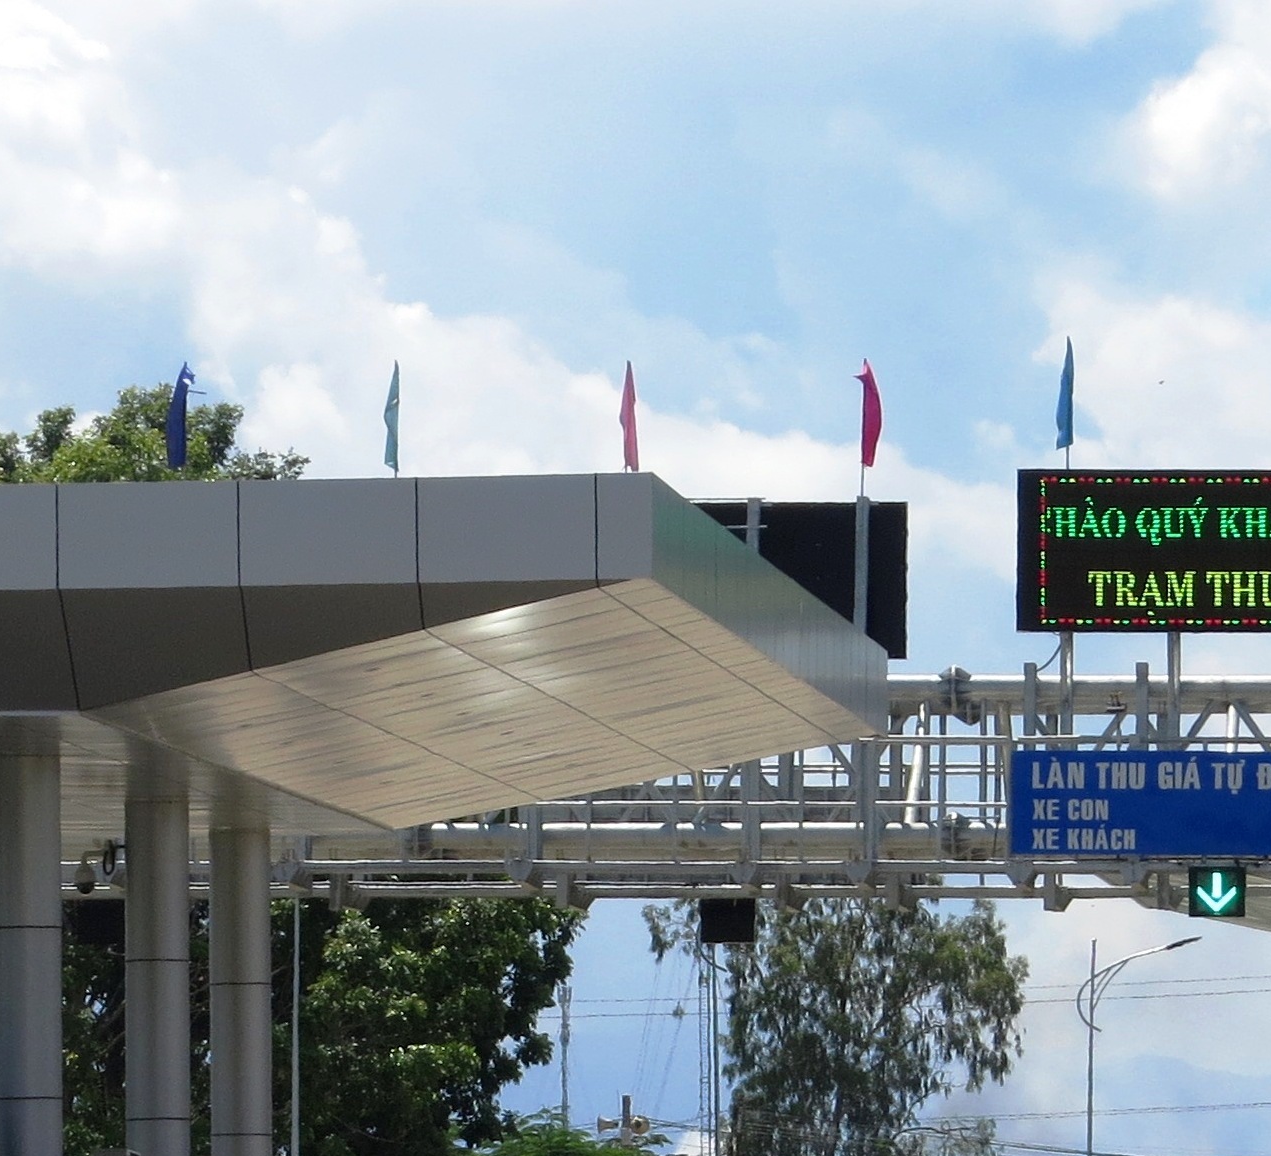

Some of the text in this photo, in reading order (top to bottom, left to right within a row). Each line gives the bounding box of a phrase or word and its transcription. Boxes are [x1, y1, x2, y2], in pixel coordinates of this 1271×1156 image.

[1135, 496, 1209, 546] QUÝ
[1087, 570, 1196, 616] TRẠM
[1032, 756, 1085, 790] LÀN
[1096, 761, 1146, 790] THU
[1157, 756, 1201, 790] GIÁ
[1211, 759, 1245, 795] TỰ
[1032, 798, 1109, 821] XE CON
[1032, 823, 1136, 850] XE KHÁCH
